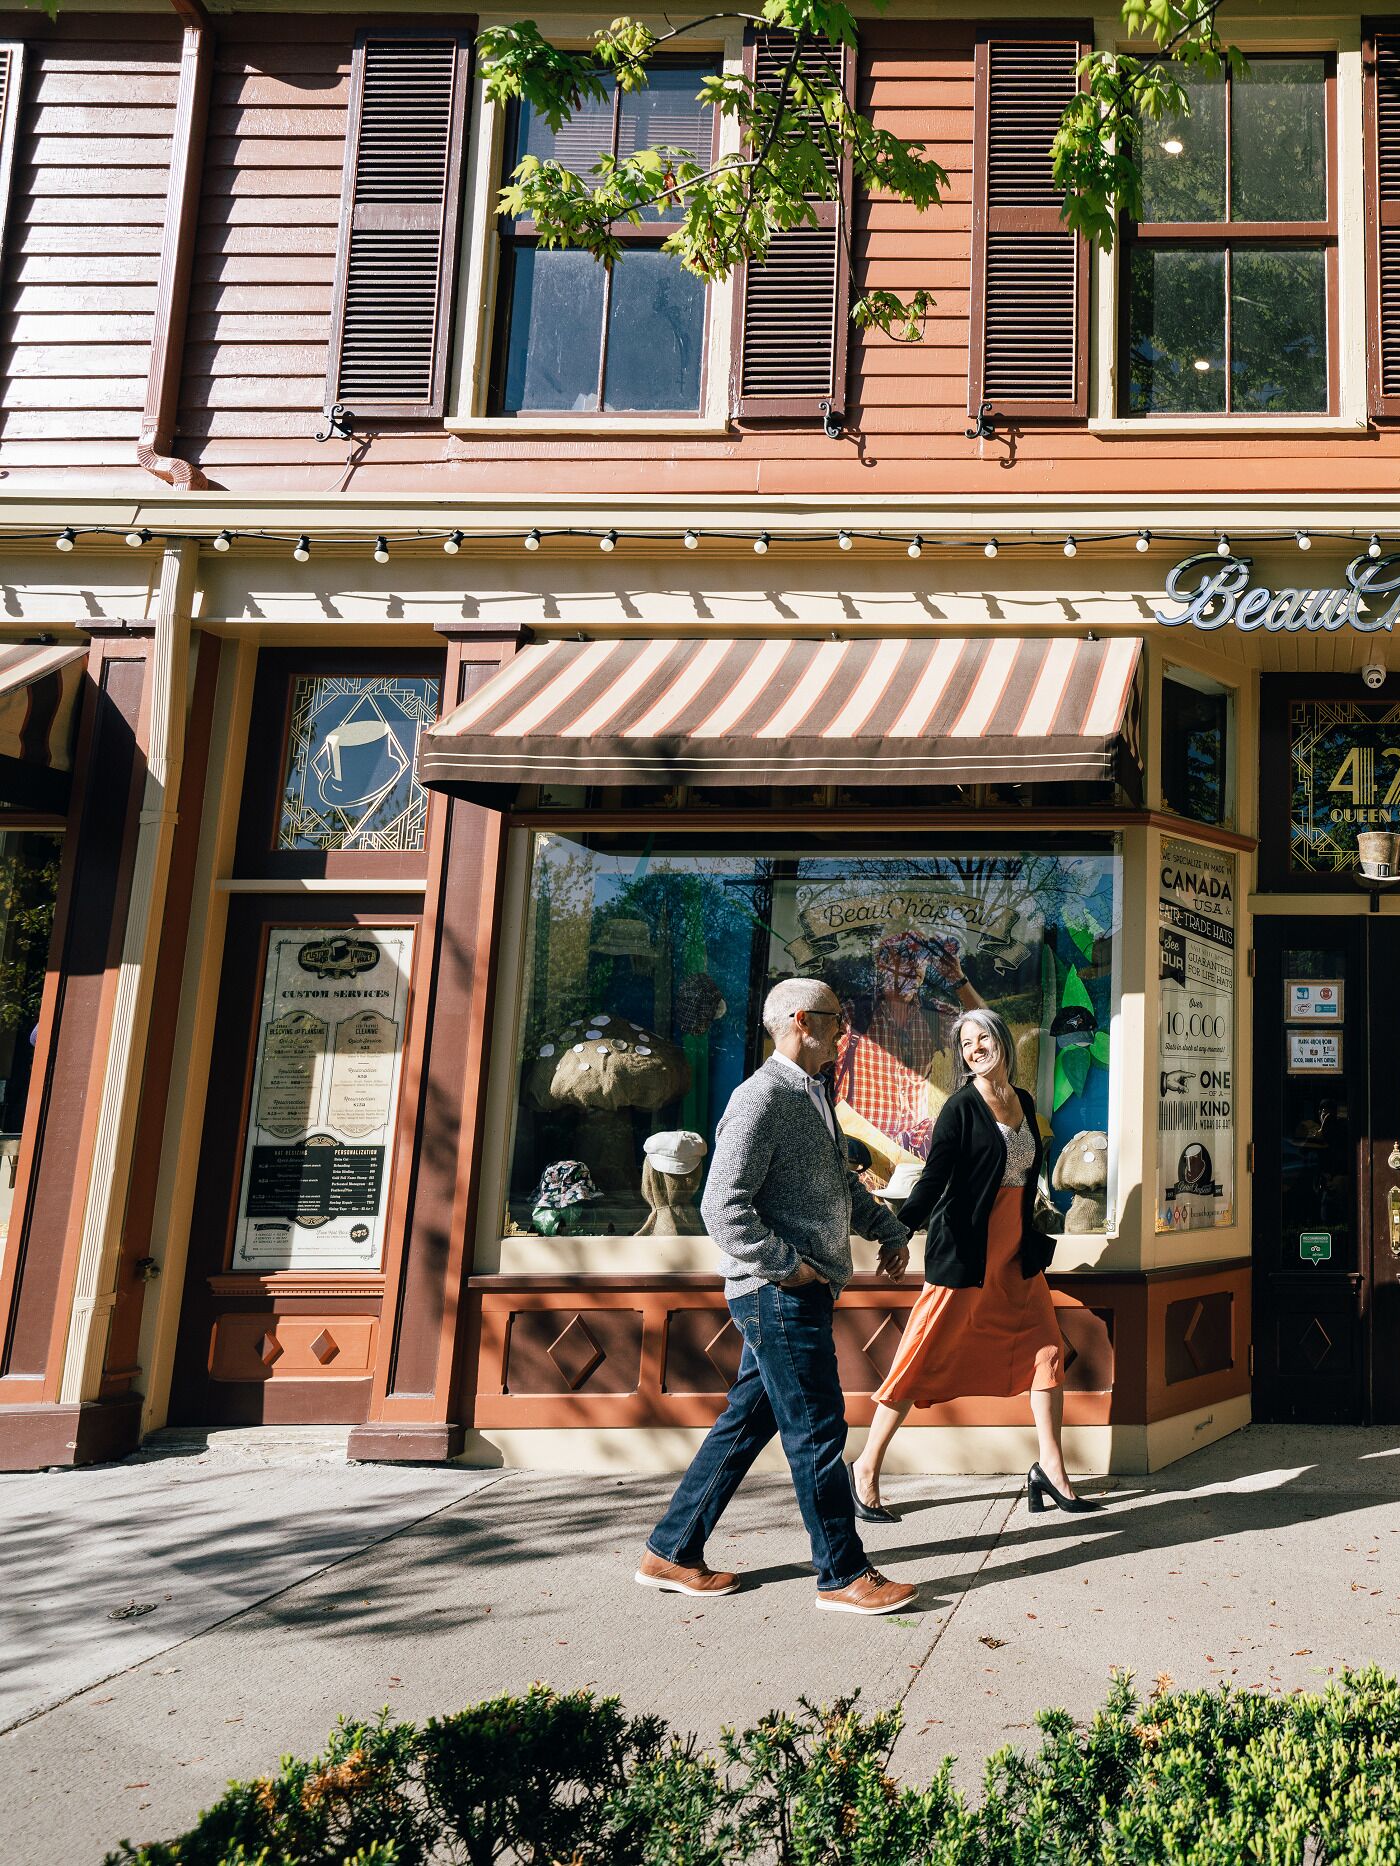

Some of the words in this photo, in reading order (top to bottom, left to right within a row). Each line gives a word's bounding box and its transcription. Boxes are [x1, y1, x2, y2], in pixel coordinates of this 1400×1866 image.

[1330, 808, 1392, 823] QUEEN
[1172, 854, 1202, 869] SPECIALIZE
[1210, 865, 1225, 874] MADE
[1161, 867, 1233, 902] CANADA
[1193, 898, 1223, 915] USA
[1225, 906, 1232, 916] &
[1160, 902, 1212, 935] FAIR-TRADE
[1213, 924, 1233, 944] HATS
[1164, 935, 1180, 952] See
[1161, 950, 1184, 971] OUR
[1188, 952, 1233, 977] GUARANTEED
[1188, 964, 1201, 976] FOR
[1202, 969, 1215, 983] LIFE
[1216, 975, 1233, 989] HATS
[282, 990, 330, 999] CUSTOM
[333, 989, 390, 998] SERVICES
[1189, 997, 1203, 1009] Over
[1166, 1011, 1226, 1040] 10,000
[1182, 1044, 1193, 1052] stock
[1200, 1070, 1231, 1089] ONE
[1200, 1100, 1231, 1117] KIND
